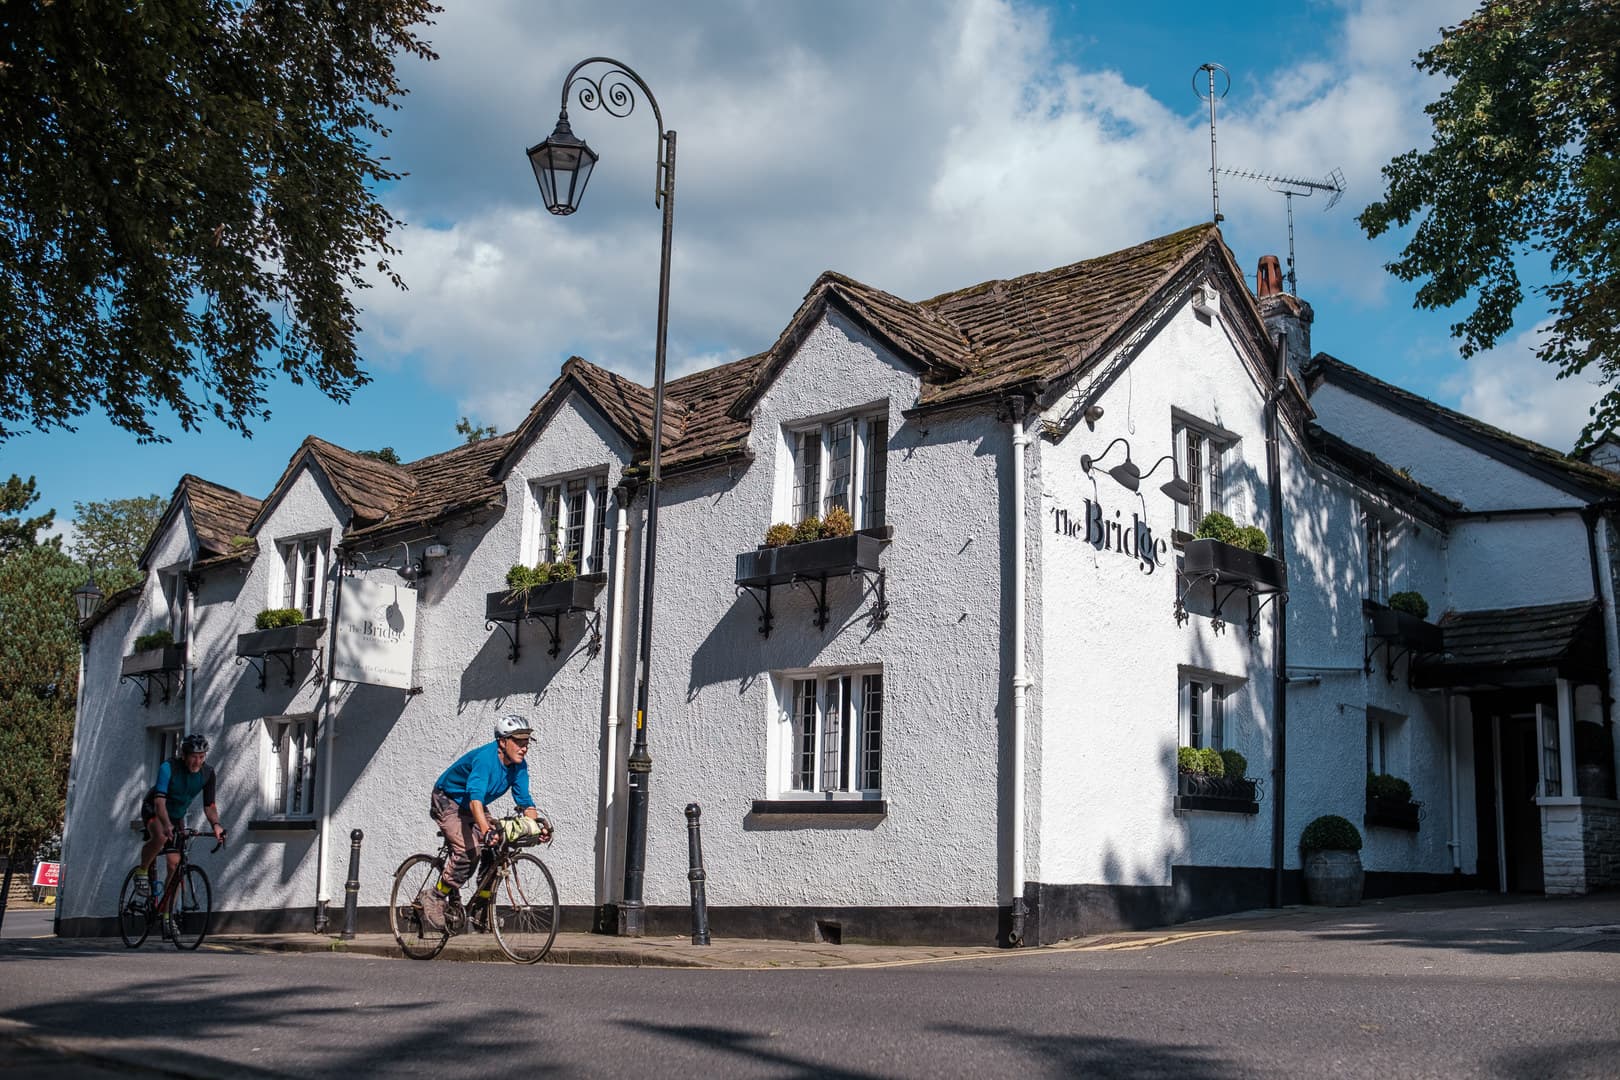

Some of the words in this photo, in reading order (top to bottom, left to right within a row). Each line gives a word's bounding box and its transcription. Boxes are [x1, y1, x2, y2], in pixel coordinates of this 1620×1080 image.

[1049, 506, 1082, 539] The
[1082, 497, 1167, 575] Bridge
[347, 623, 362, 634] The
[362, 620, 406, 643] Bridge
